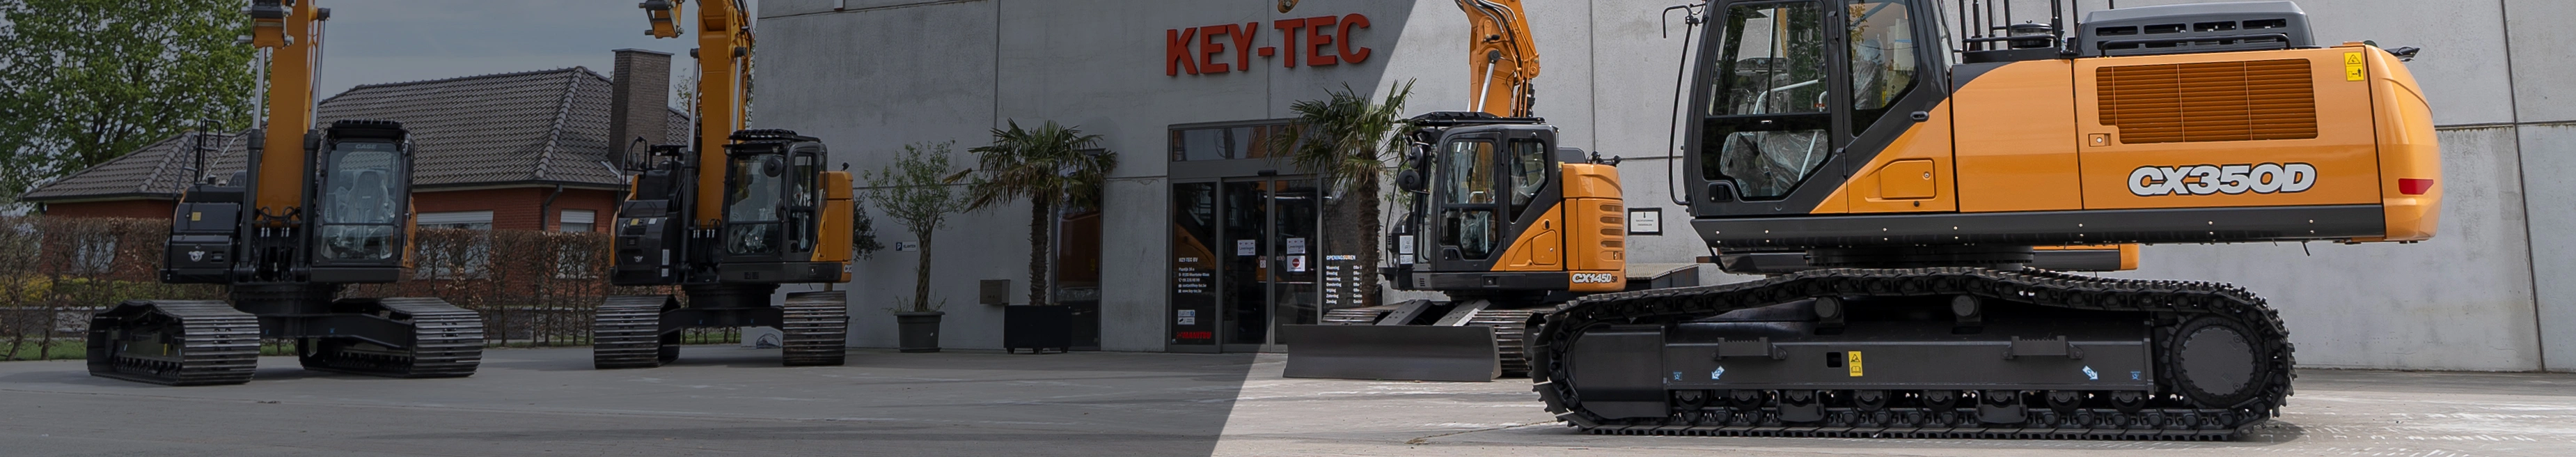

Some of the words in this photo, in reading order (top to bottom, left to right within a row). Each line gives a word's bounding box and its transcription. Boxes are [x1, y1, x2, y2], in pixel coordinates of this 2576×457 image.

[1166, 13, 1372, 77] KEY-TEC
[2127, 162, 2318, 197] CX350D
[1572, 272, 1612, 284] CX145D
